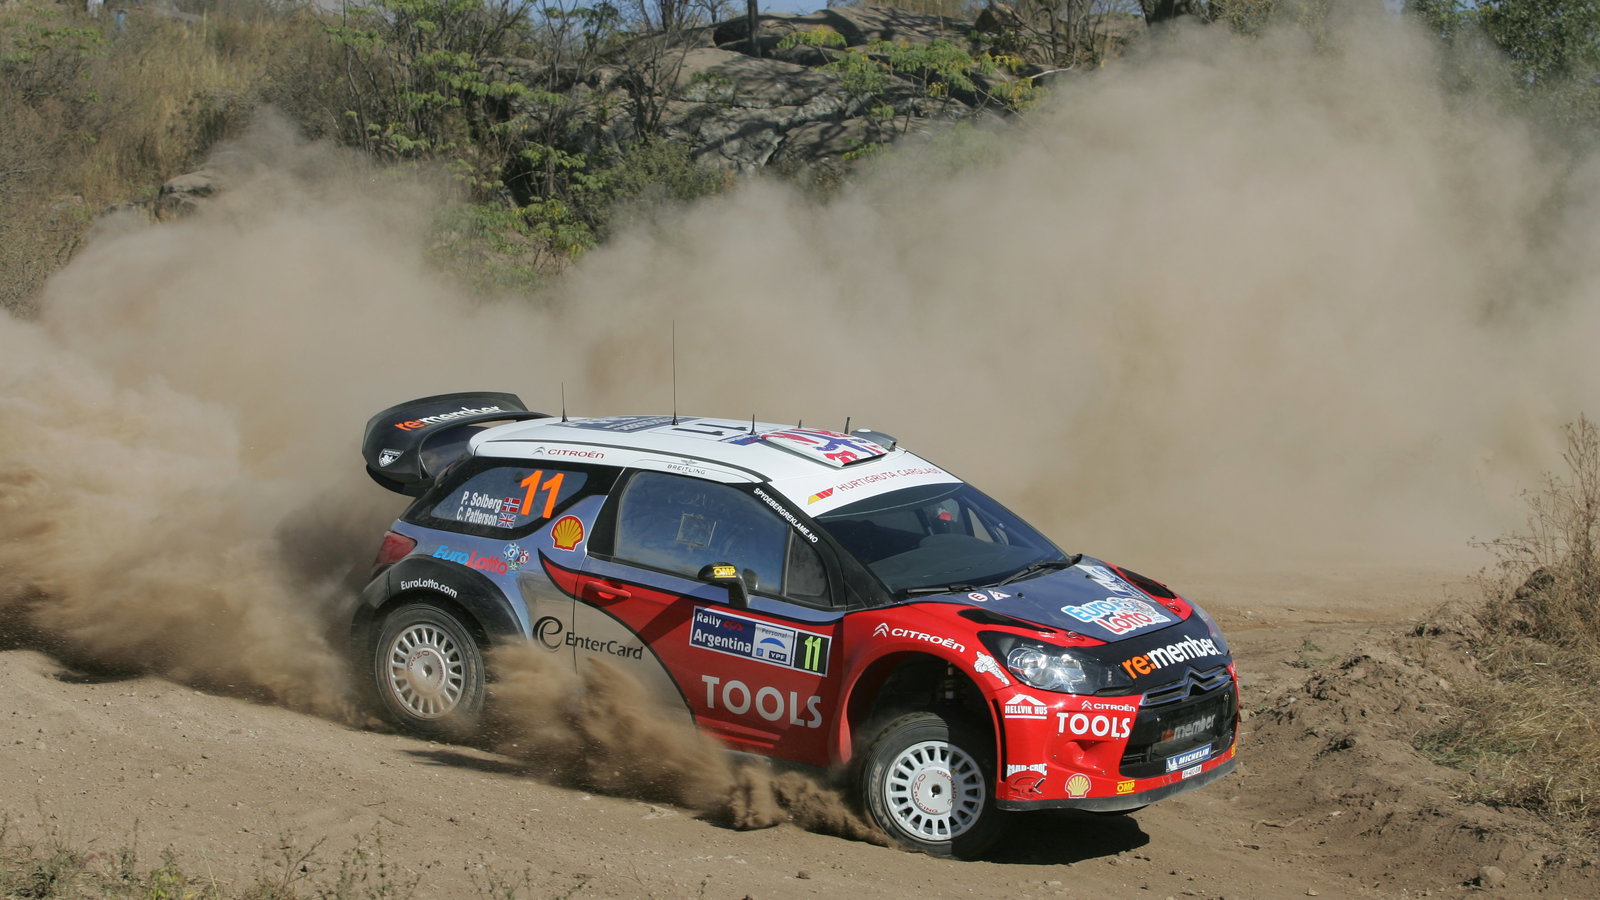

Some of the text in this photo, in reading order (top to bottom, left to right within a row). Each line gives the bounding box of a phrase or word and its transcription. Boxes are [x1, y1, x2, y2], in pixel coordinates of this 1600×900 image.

[395, 404, 500, 431] re:member
[667, 464, 706, 474] BREITLING
[837, 471, 896, 492] HURTIGRUTA
[460, 491, 503, 513] P. Solberg
[520, 470, 565, 519] 11
[456, 507, 498, 526] C. Patterson
[753, 487, 819, 544] SPYDEBERGREKLAME.NO
[713, 568, 736, 576] OMP
[400, 577, 458, 599] EuroLotto.com
[697, 612, 721, 628] Rally
[693, 628, 752, 653] Argentina
[760, 628, 788, 639] Personal
[565, 631, 643, 660] EnterCard
[770, 652, 786, 661] YPF
[804, 635, 822, 672] 11
[1122, 634, 1220, 679] re:member
[701, 674, 823, 729] TOOLS
[1004, 705, 1048, 715] HELLVIK HUS
[1056, 712, 1131, 738] TOOLS
[1178, 747, 1210, 764] MICHELIN
[1117, 782, 1135, 792] OMP
